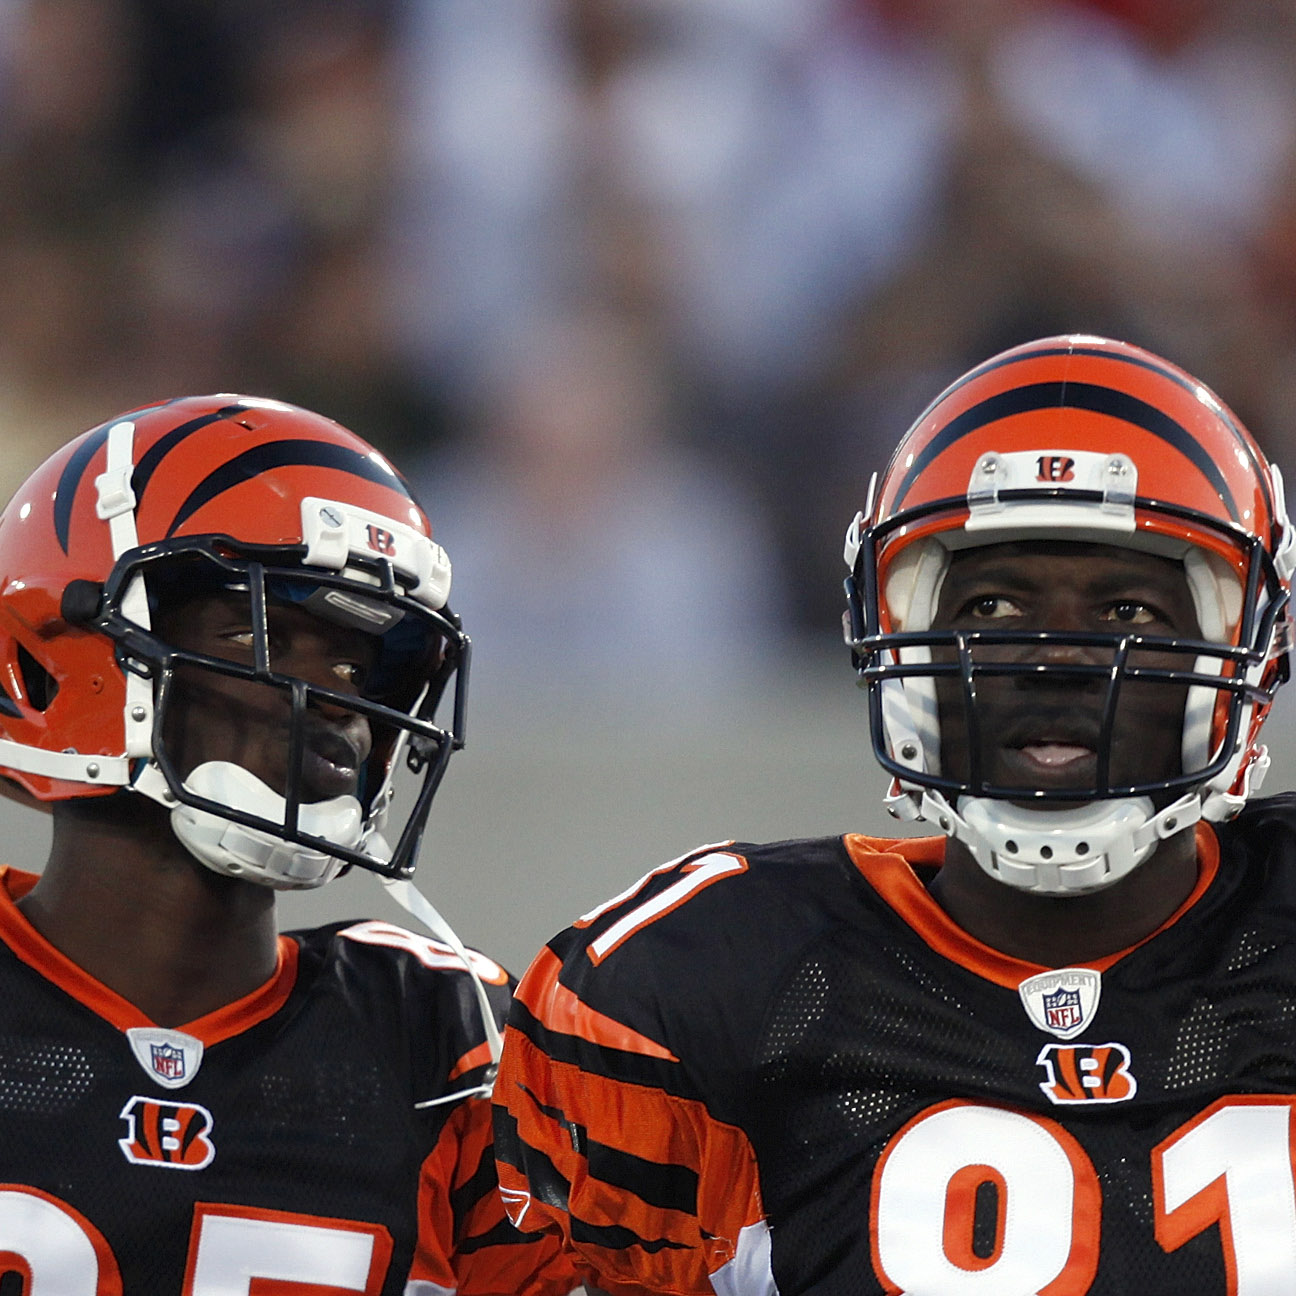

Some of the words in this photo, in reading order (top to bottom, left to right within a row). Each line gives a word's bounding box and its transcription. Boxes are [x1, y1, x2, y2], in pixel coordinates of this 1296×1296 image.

[572, 840, 750, 967] 1
[1026, 973, 1094, 996] EQUIPMENT
[1048, 1007, 1080, 1028] NFL
[155, 1056, 182, 1076] NFL
